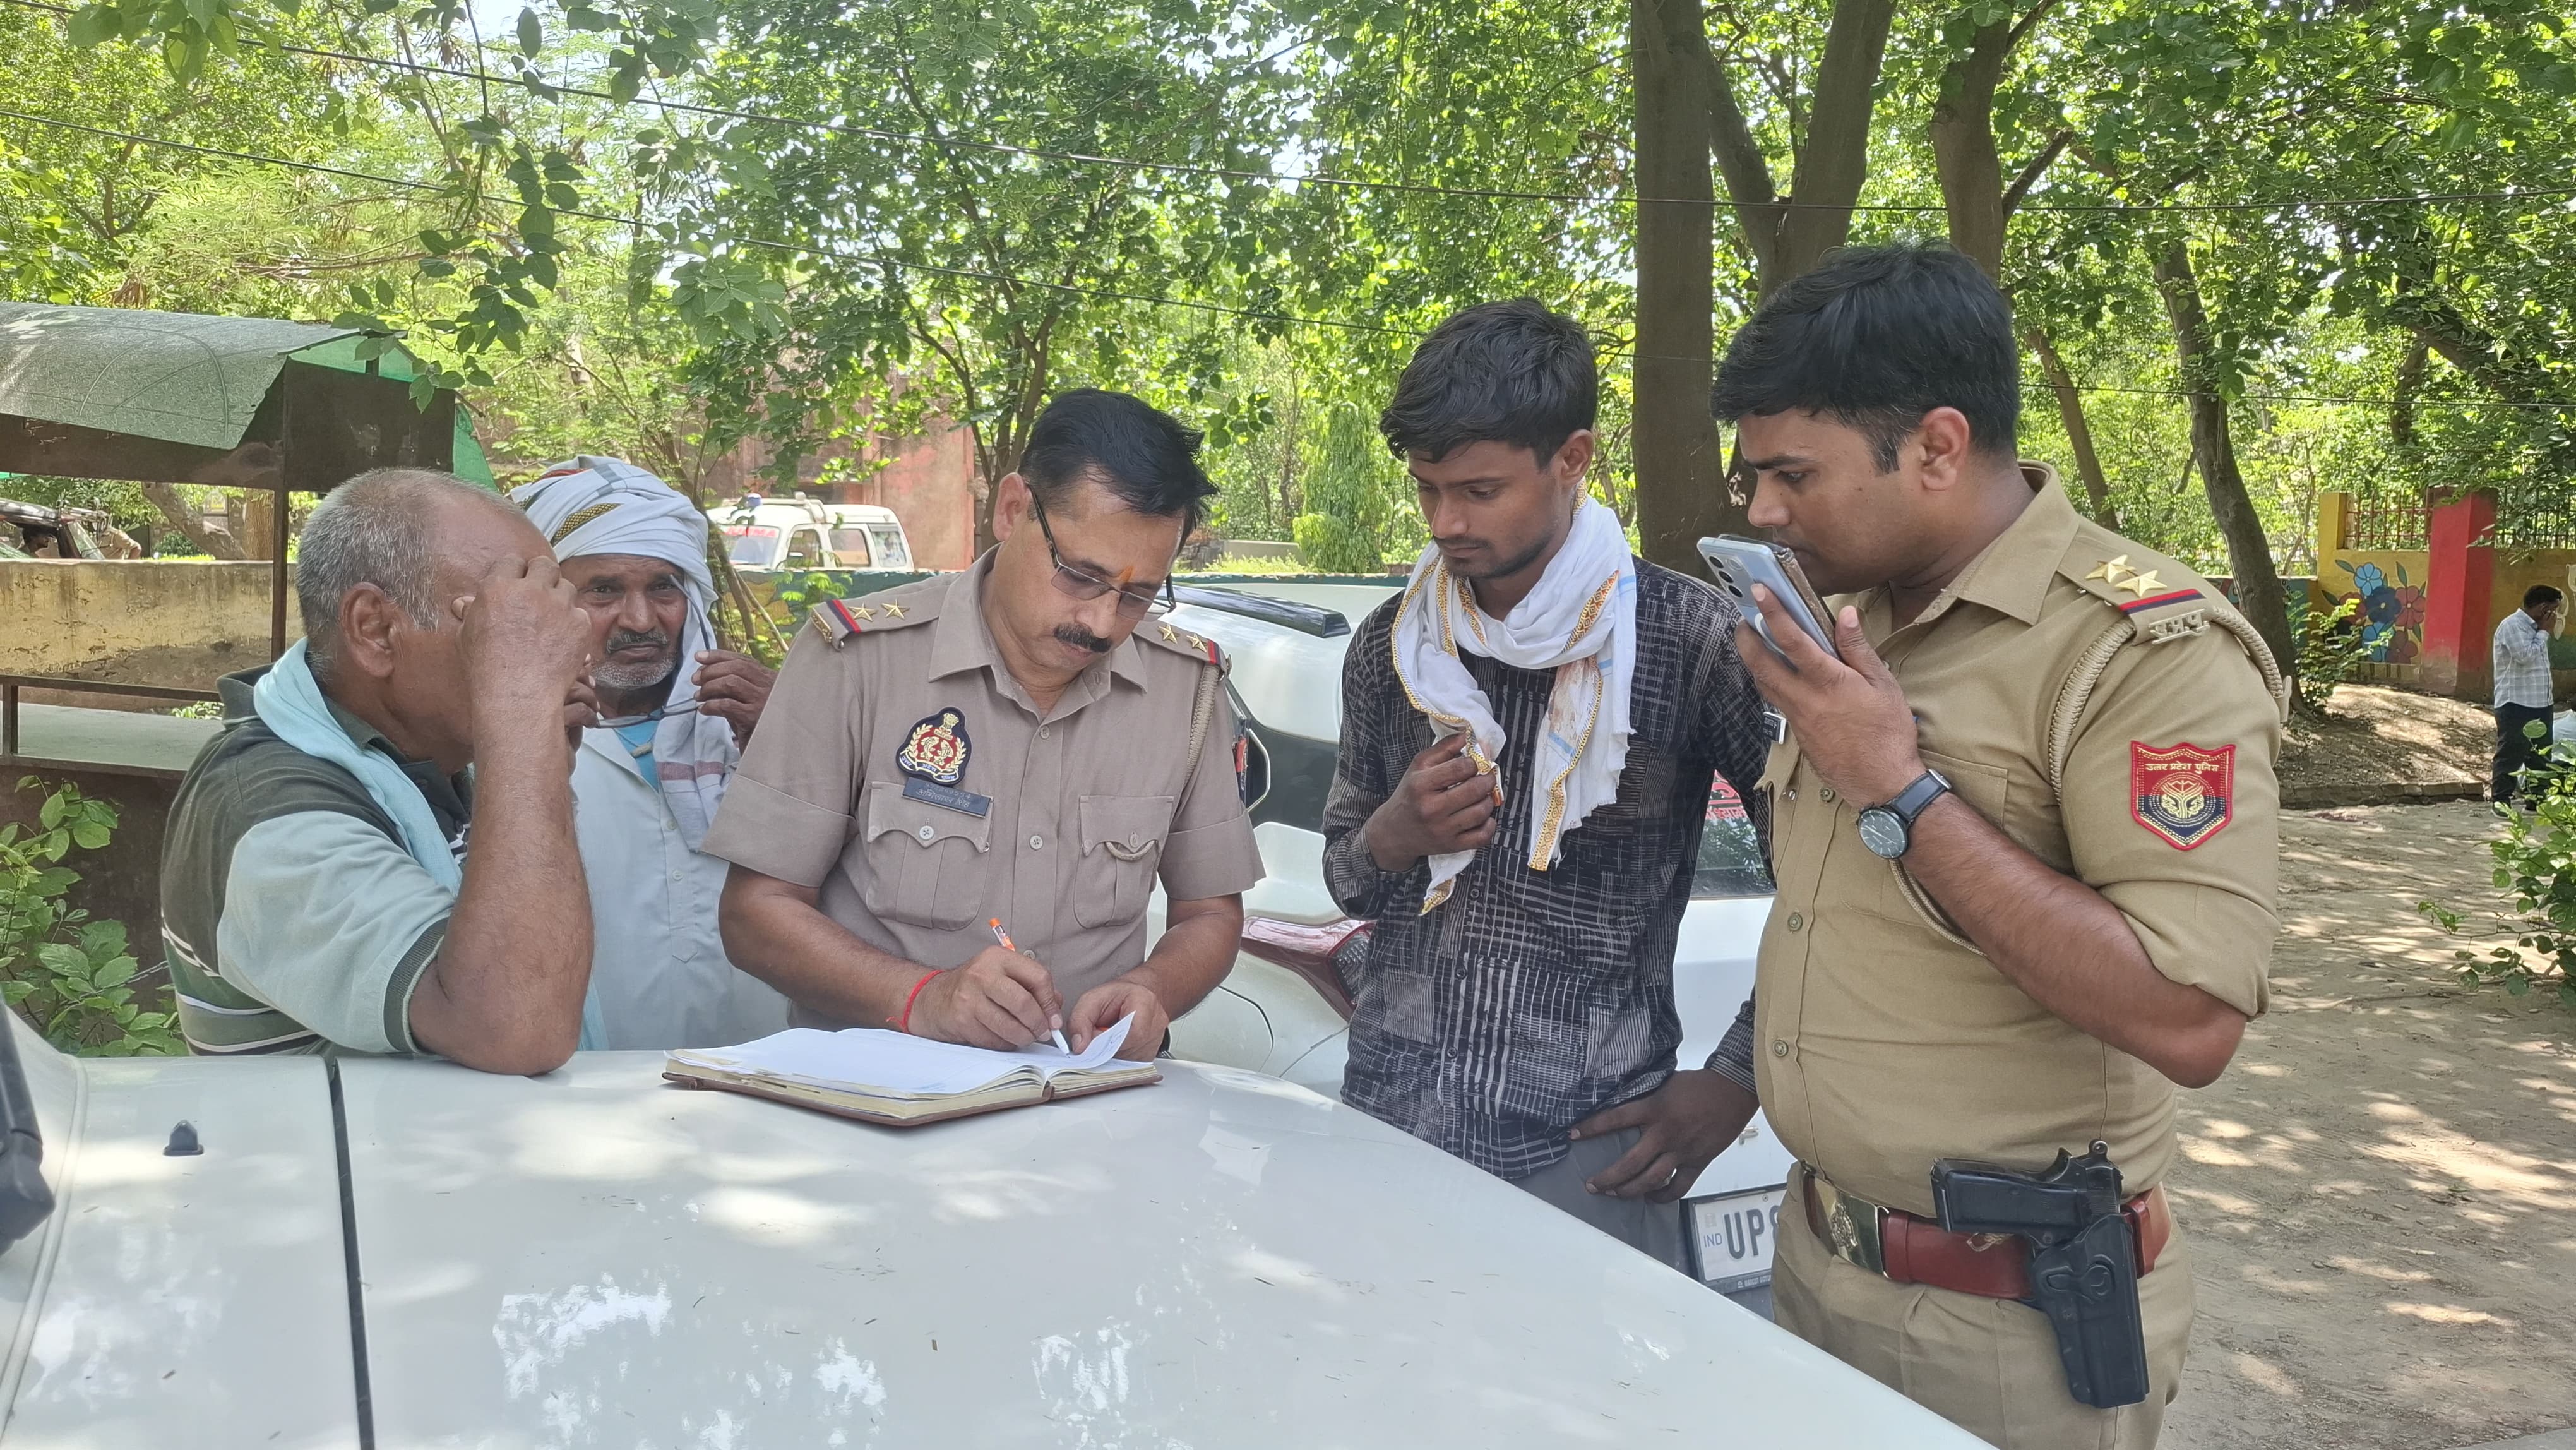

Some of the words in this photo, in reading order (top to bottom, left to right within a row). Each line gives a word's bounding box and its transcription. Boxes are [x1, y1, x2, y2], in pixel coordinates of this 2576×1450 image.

[2145, 762, 2168, 771] उत्तर
[2169, 761, 2191, 772] प्रदेश
[2194, 762, 2220, 774] पुलिस
[1703, 1233, 1722, 1248] IND
